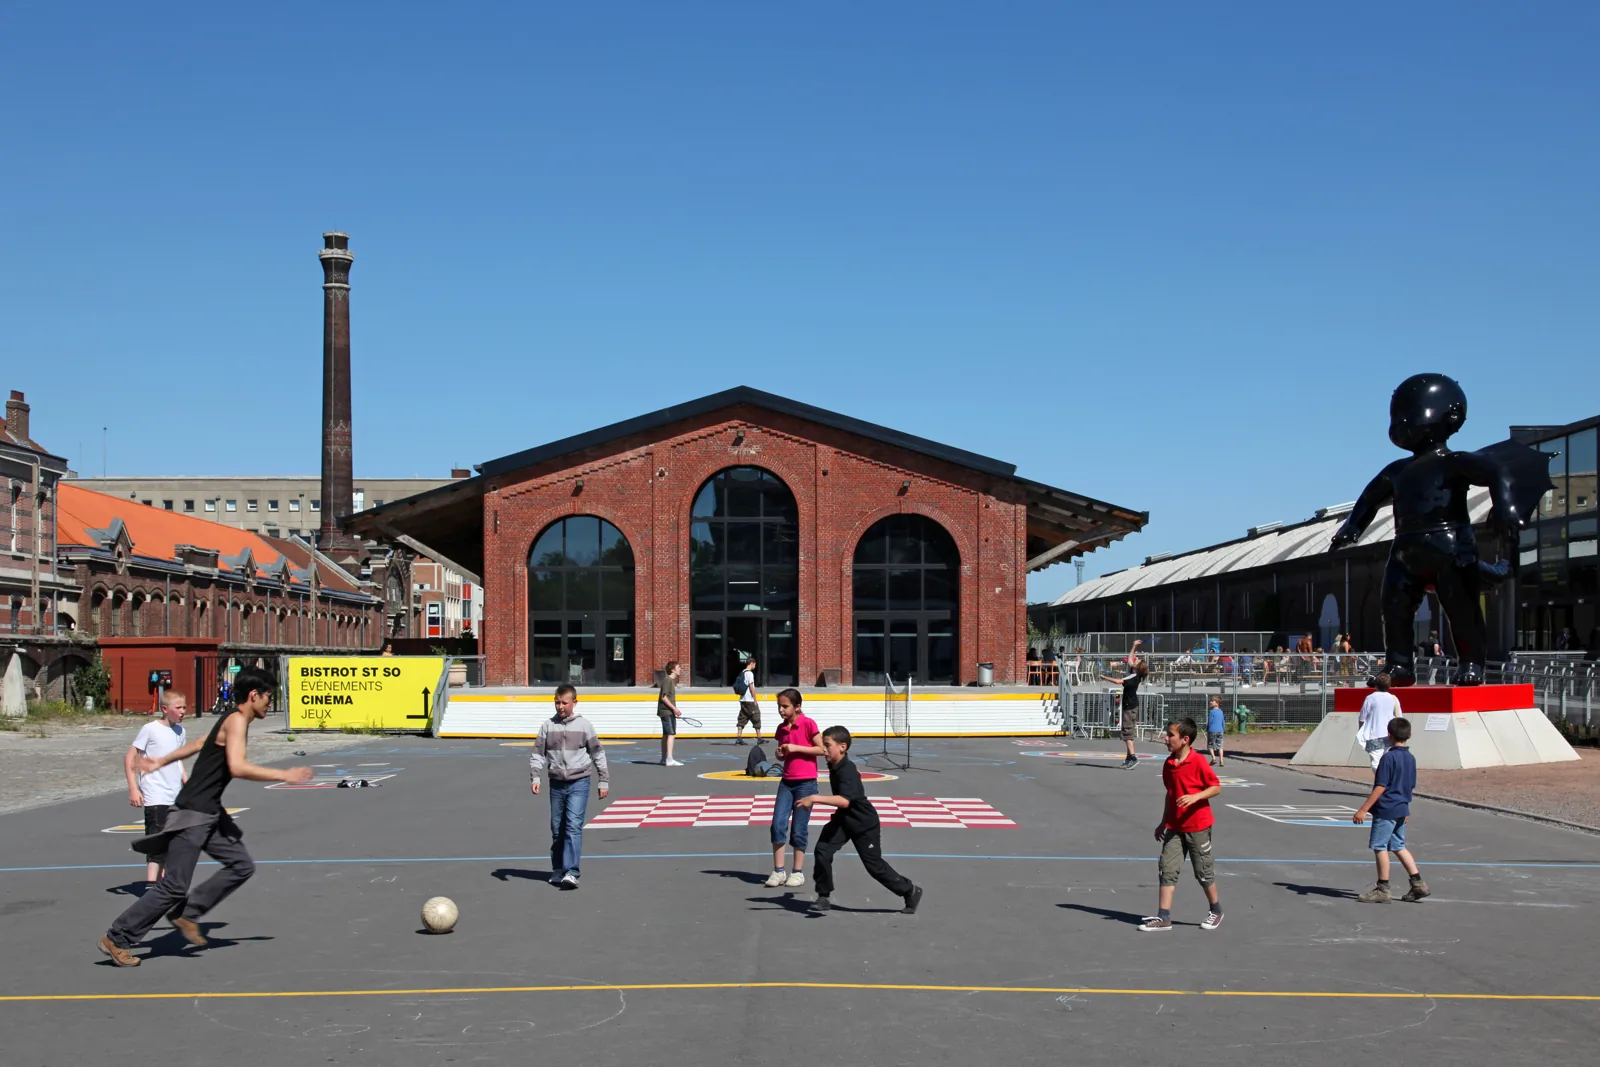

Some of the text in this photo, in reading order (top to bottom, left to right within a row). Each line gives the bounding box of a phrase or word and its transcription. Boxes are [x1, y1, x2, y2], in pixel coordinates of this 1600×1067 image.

[301, 667, 401, 677] BISTROT ST SO
[301, 679, 383, 691] ÉVÉNEMENTS
[301, 693, 353, 705] CINÉMA
[301, 709, 332, 719] JEUX
